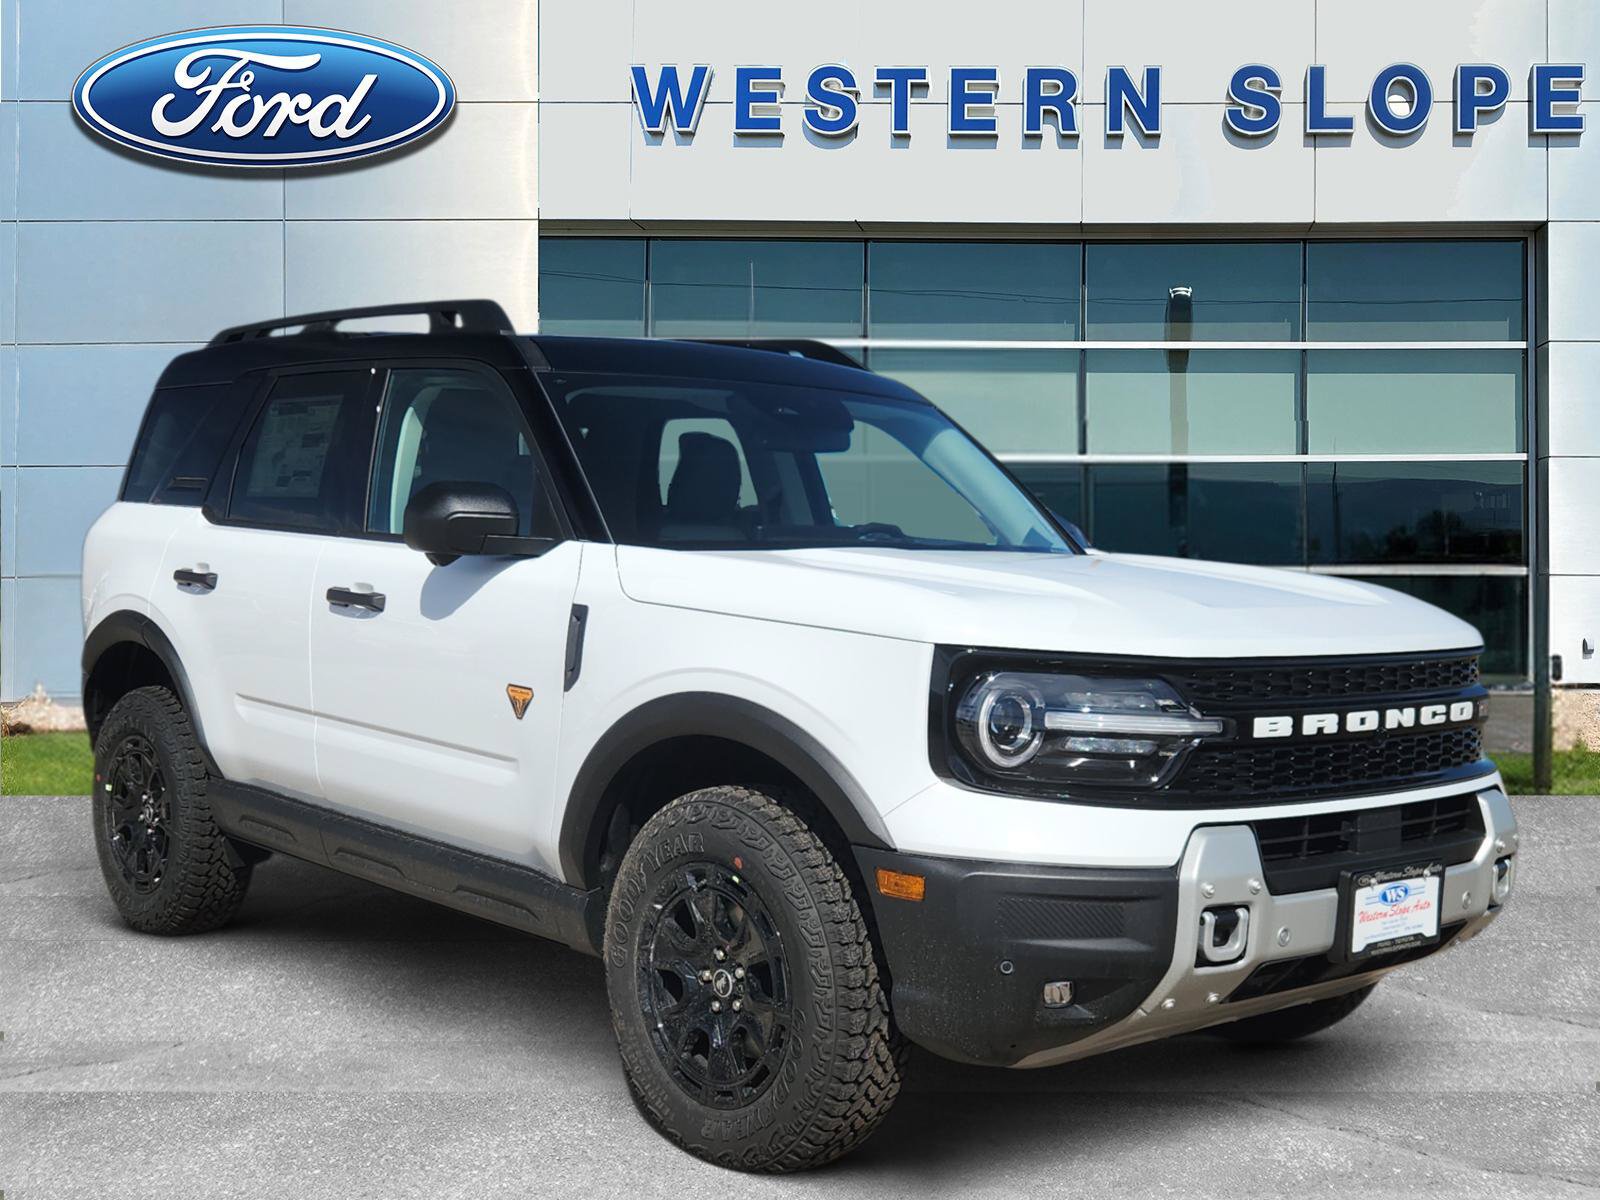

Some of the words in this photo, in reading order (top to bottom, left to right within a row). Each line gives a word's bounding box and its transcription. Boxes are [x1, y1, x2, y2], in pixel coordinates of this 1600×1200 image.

[151, 48, 378, 138] Ford
[630, 64, 1162, 136] WESTERN
[1224, 63, 1586, 134] SLOPE
[1253, 702, 1473, 738] BRONCO
[1359, 911, 1388, 923] Western
[1389, 903, 1411, 917] Slope
[1412, 900, 1431, 912] Auto
